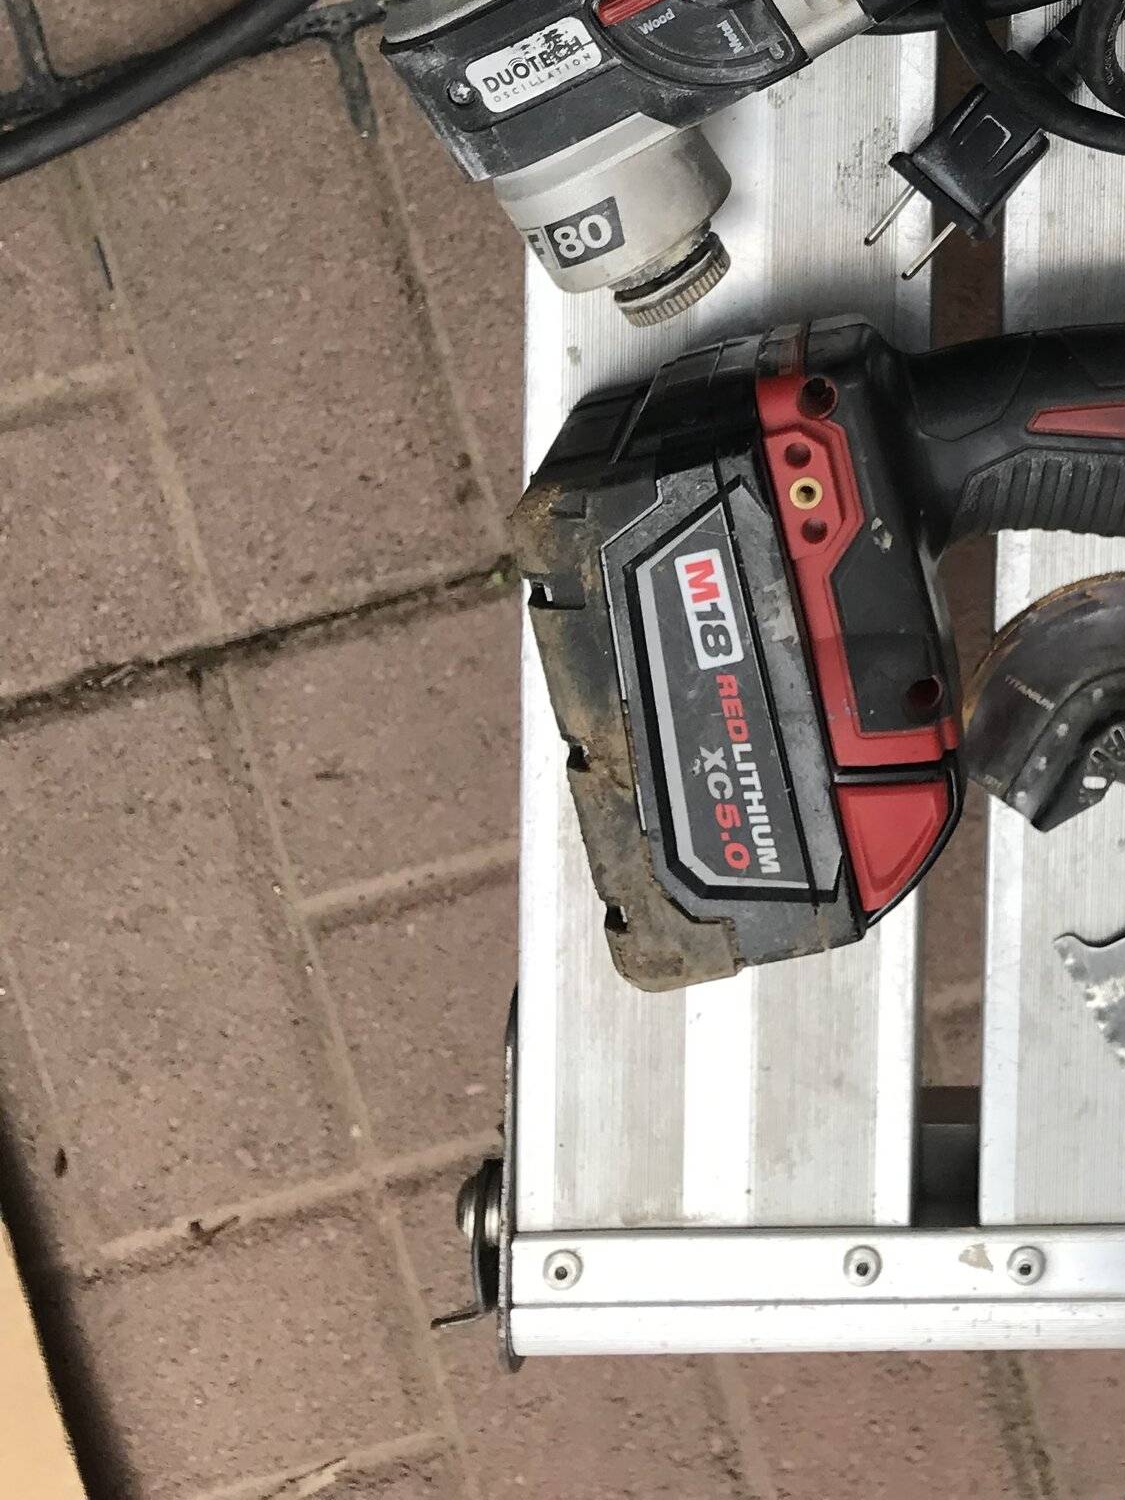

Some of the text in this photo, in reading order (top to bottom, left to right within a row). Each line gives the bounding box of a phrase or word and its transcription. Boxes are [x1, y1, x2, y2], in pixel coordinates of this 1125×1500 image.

[637, 7, 676, 36] Wood
[716, 19, 745, 54] Metal
[482, 35, 585, 94] DUOTECH
[494, 52, 592, 103] OSCILLATION
[553, 214, 613, 259] 80
[684, 557, 734, 659] M18
[716, 672, 781, 875] REDLITHIUM
[699, 746, 750, 871] XC5.0
